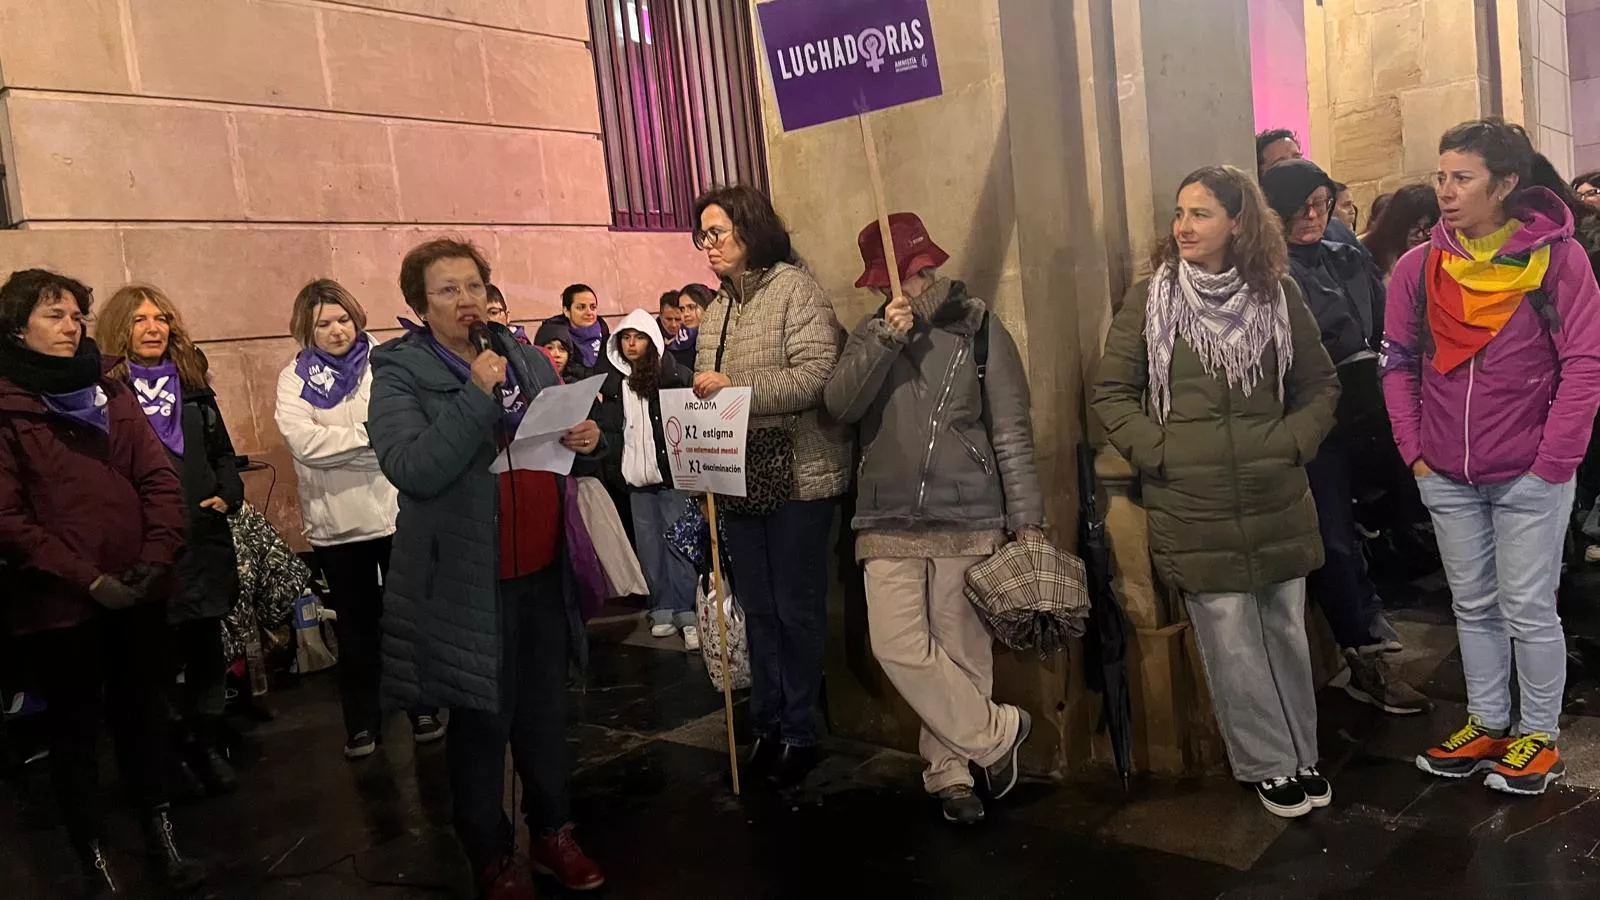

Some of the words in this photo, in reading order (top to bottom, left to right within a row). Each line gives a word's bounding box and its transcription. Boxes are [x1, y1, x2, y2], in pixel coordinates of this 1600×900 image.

[777, 19, 924, 80] LUCHADORAS
[684, 402, 717, 410] ARCADIA
[703, 427, 733, 440] estigma
[702, 463, 741, 473] discriminación
